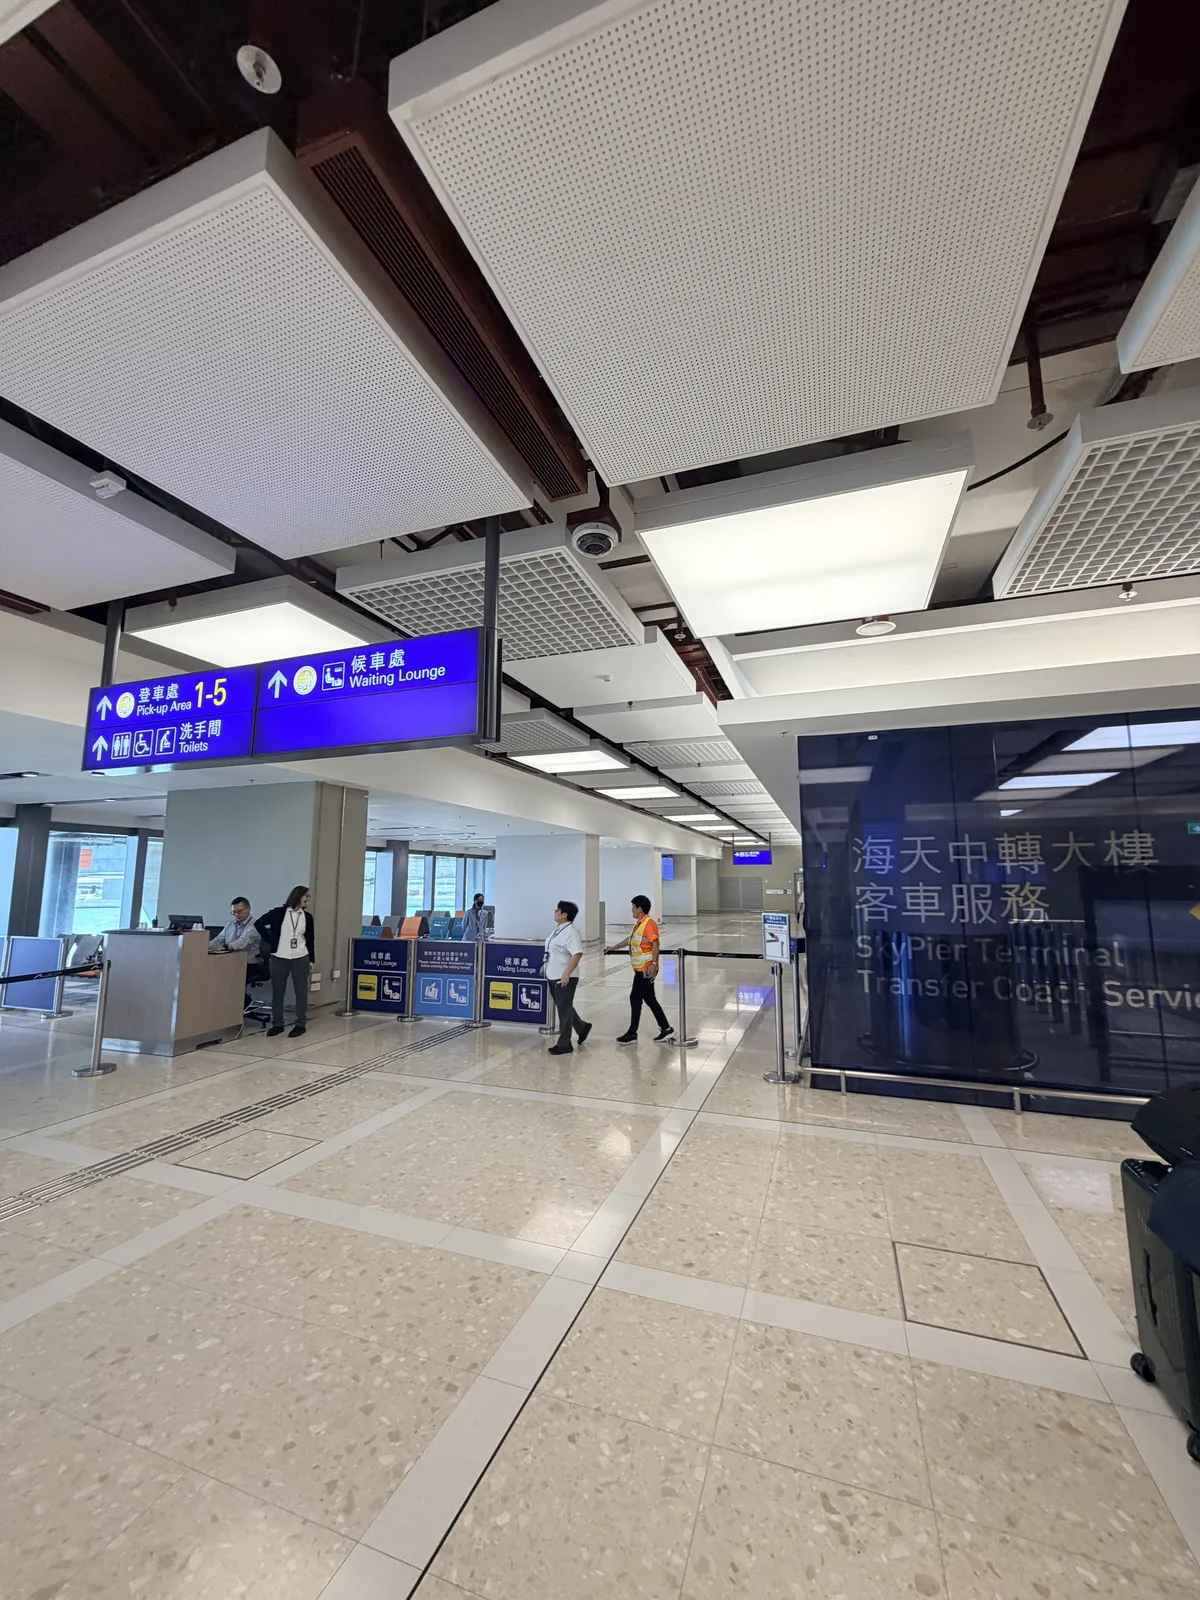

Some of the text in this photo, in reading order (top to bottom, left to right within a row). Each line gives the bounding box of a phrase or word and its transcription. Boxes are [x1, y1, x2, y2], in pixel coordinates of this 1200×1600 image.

[350, 648, 405, 674] 候車處
[349, 666, 446, 688] Waiting Lounge
[138, 682, 179, 703] 登車處
[194, 678, 227, 708] 1-5
[136, 700, 192, 716] Pick-up Area
[178, 719, 222, 741] 洗手間
[178, 741, 209, 754] Toilets
[851, 829, 1159, 874] 海天中轉大樓
[854, 881, 1050, 924] 客車服務
[856, 934, 1125, 967] SkyPier Terminal
[363, 959, 398, 968] Waiting Lounge
[496, 965, 537, 974] Waiting Lounge
[856, 969, 1200, 1011] Transfer Coach Servi
